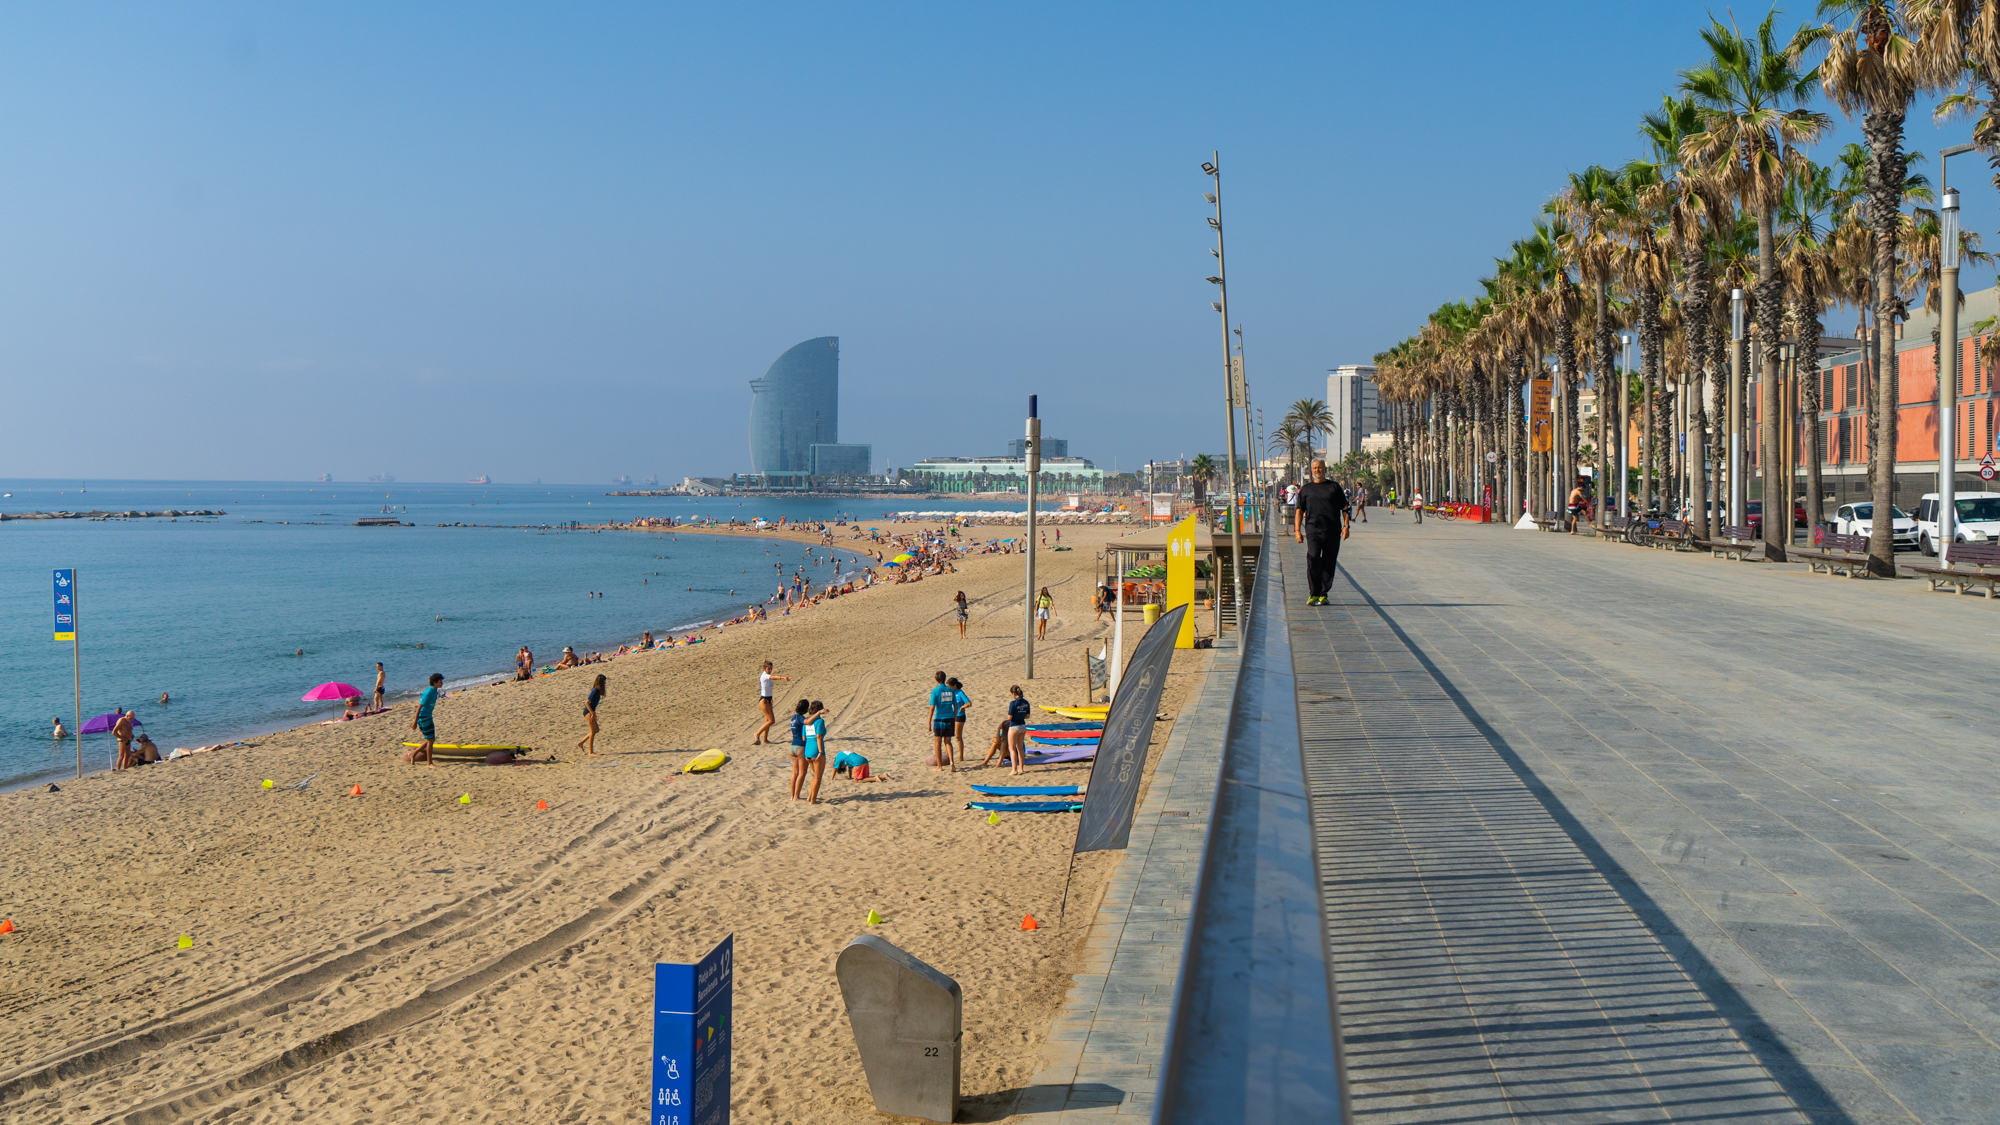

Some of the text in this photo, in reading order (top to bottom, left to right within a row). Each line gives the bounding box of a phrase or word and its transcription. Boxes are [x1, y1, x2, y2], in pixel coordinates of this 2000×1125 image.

[828, 339, 838, 348] W
[1233, 359, 1241, 405] OPOLLO
[720, 948, 730, 981] 12
[924, 1046, 939, 1057] 22
